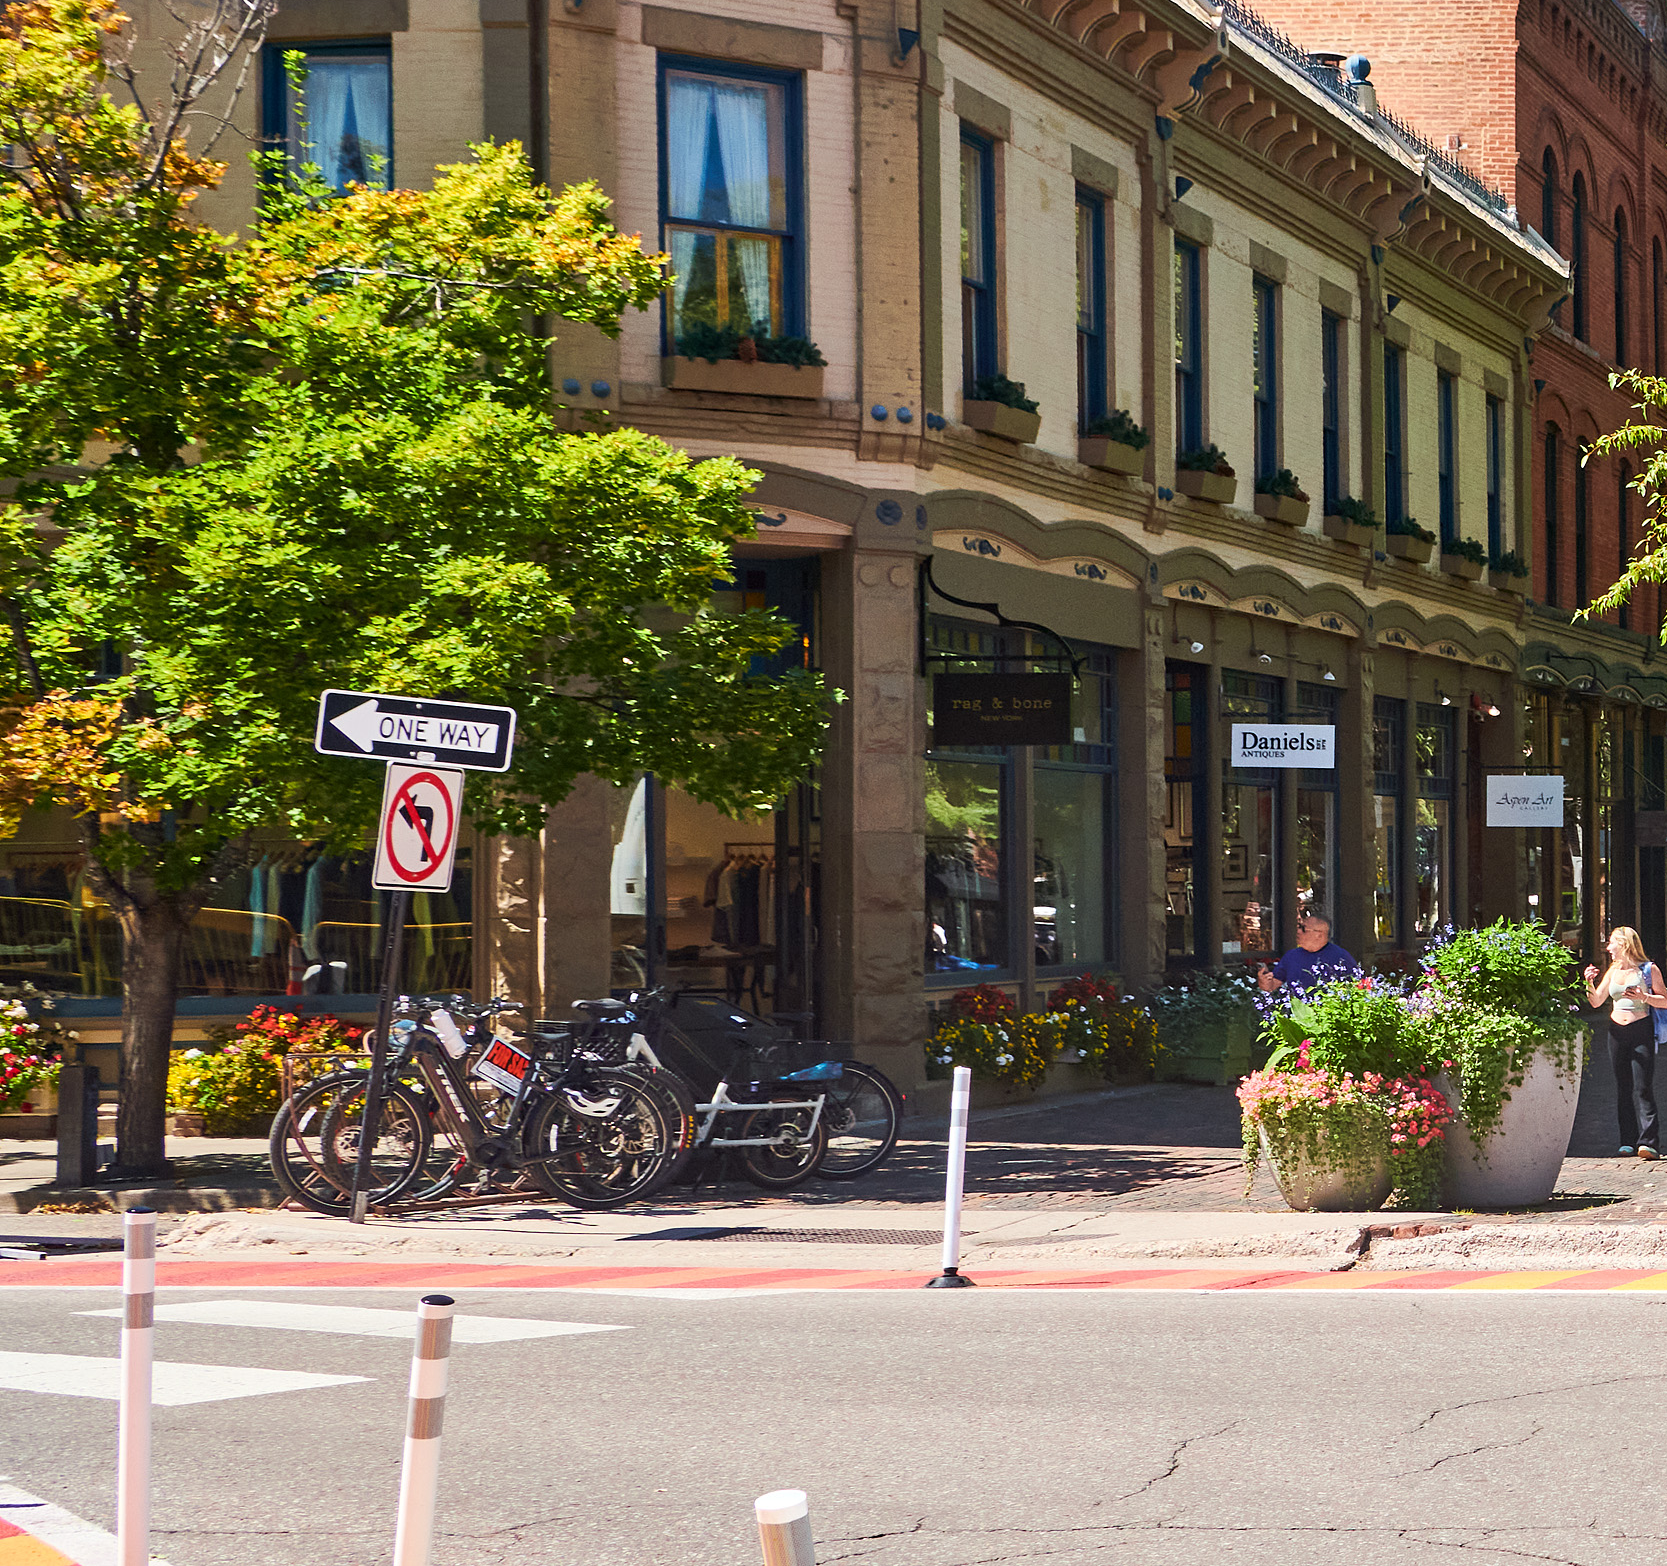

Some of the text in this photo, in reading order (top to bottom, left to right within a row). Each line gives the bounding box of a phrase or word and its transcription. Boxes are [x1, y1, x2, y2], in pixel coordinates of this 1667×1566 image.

[952, 697, 1053, 711] rag & bone
[379, 717, 490, 748] ONE WAY
[1241, 731, 1315, 750] Daniels
[1496, 792, 1554, 808] Aspen Art
[486, 1040, 514, 1070] FOR
[435, 1064, 470, 1123] TREK
